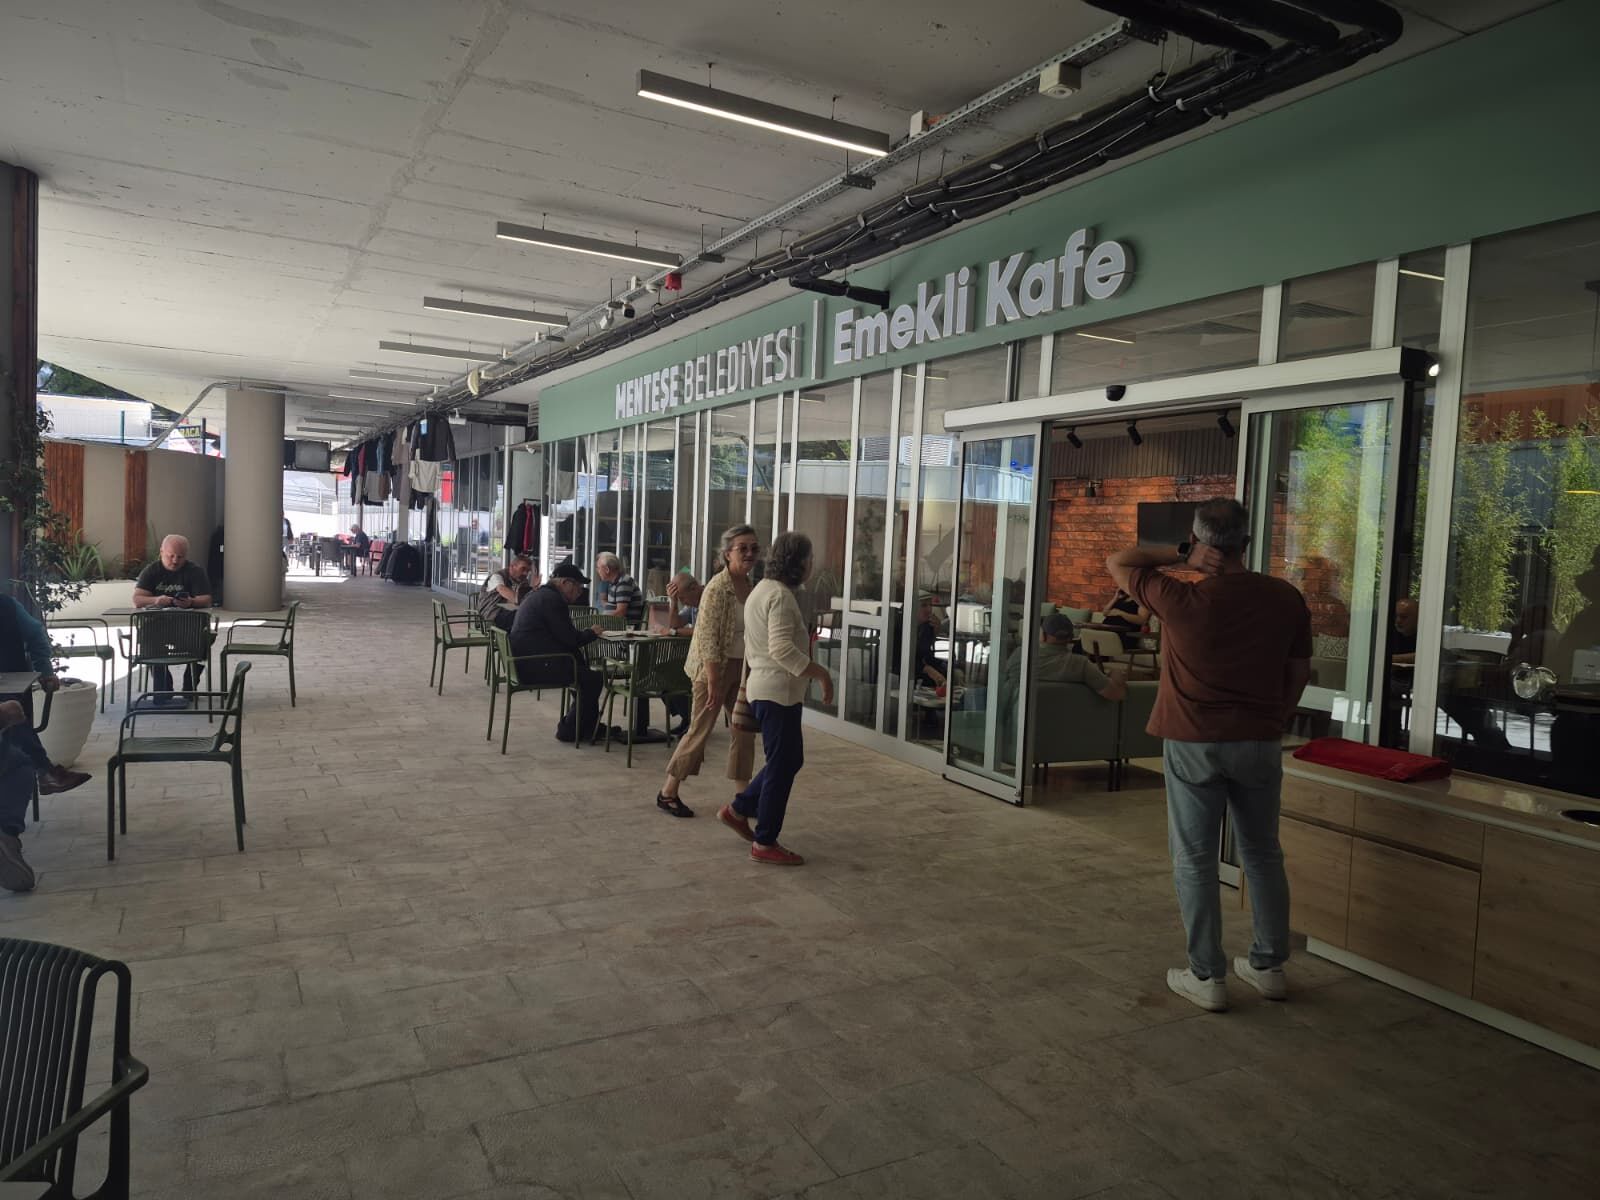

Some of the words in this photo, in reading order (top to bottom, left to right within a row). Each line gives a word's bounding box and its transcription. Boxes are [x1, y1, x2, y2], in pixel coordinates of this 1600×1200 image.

[615, 364, 679, 420] MENTEŞE
[683, 325, 797, 404] BELEDİYESİ
[833, 266, 971, 365] Emekli
[985, 228, 1127, 327] Kafe
